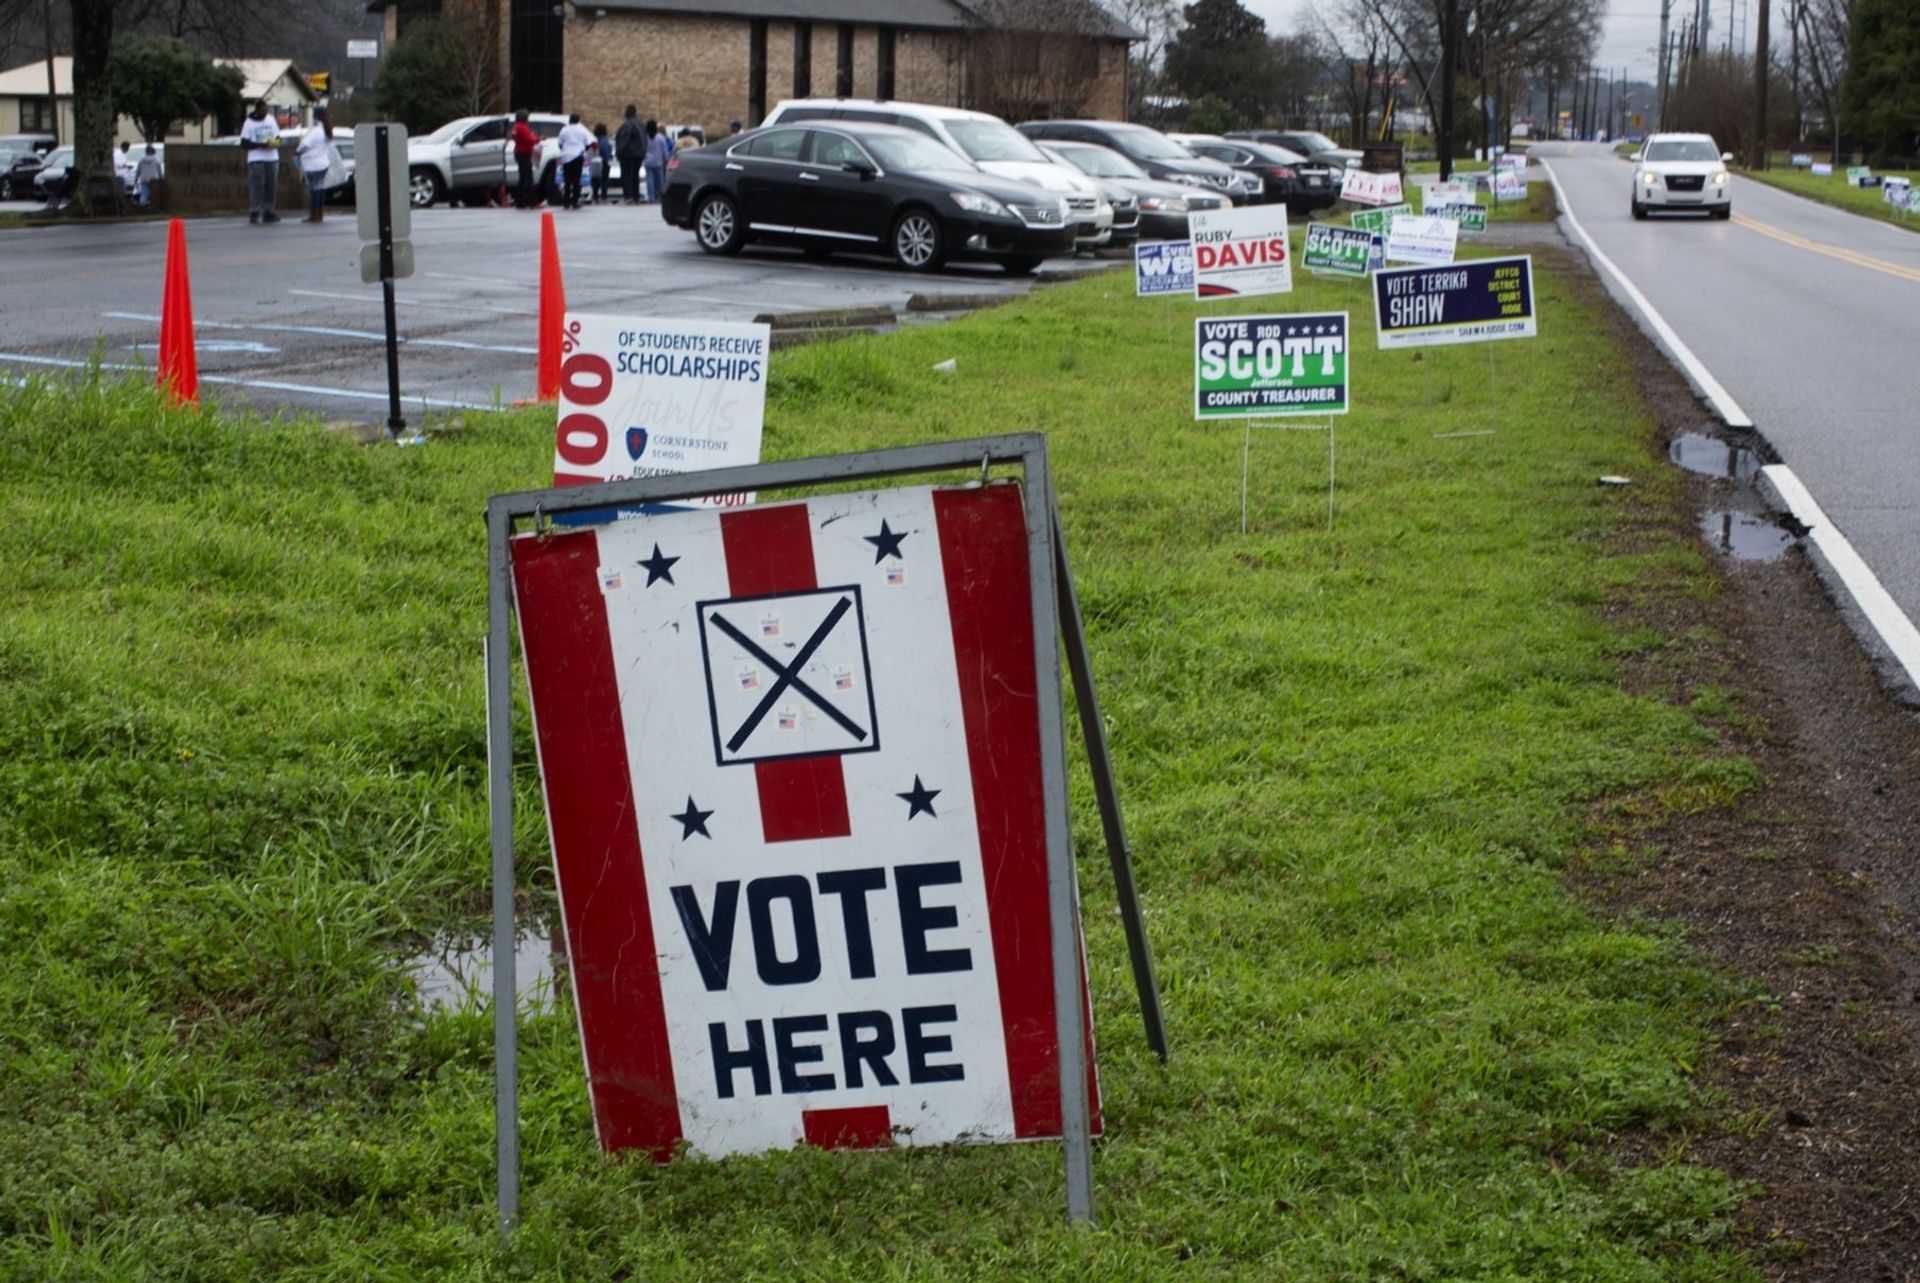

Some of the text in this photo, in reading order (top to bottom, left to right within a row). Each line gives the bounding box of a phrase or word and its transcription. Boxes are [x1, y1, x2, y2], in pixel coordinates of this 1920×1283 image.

[1195, 230, 1233, 244] RUBY
[1308, 234, 1369, 259] SCOTT
[1197, 239, 1286, 269] DAVIS
[1387, 270, 1468, 296] VOTE TERRIKA
[1487, 279, 1520, 292] DISTRICT
[1497, 292, 1521, 303] COURT
[1390, 293, 1444, 327] SHAW
[1205, 322, 1281, 340] VOTE ROD
[618, 332, 762, 355] OF STUDENTS RECEIVE
[617, 352, 760, 382] SCHOLARSHIPS
[1201, 336, 1343, 381] SCOTT
[1251, 378, 1293, 389] Jefferson
[1207, 387, 1336, 406] COUNTY TREASURER
[653, 435, 729, 451] CORNERSTONE
[652, 450, 685, 461] SCHOOL
[669, 860, 974, 992] VOTE
[708, 1004, 966, 1099] HERE
